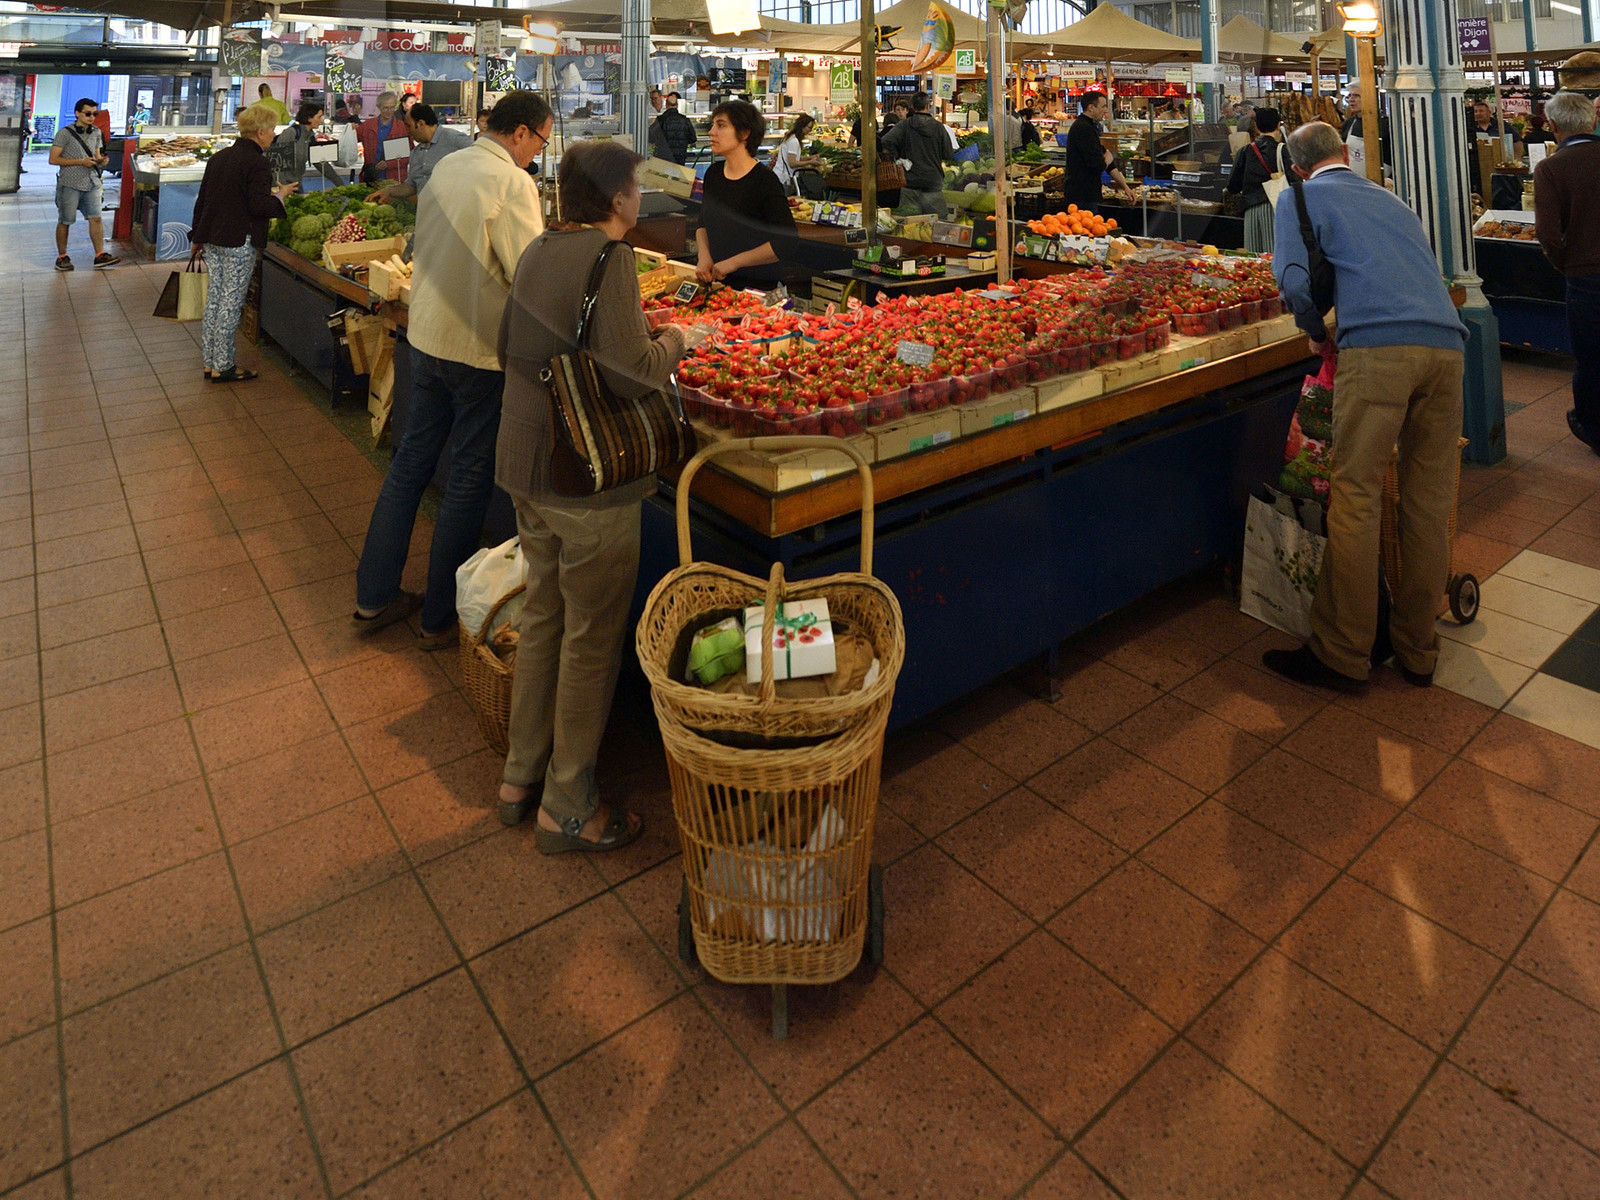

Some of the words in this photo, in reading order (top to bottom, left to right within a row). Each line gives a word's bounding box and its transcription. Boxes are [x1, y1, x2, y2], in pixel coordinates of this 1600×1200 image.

[1458, 18, 1487, 28] nnière
[1464, 28, 1488, 38] Dijon
[832, 71, 850, 89] AB
